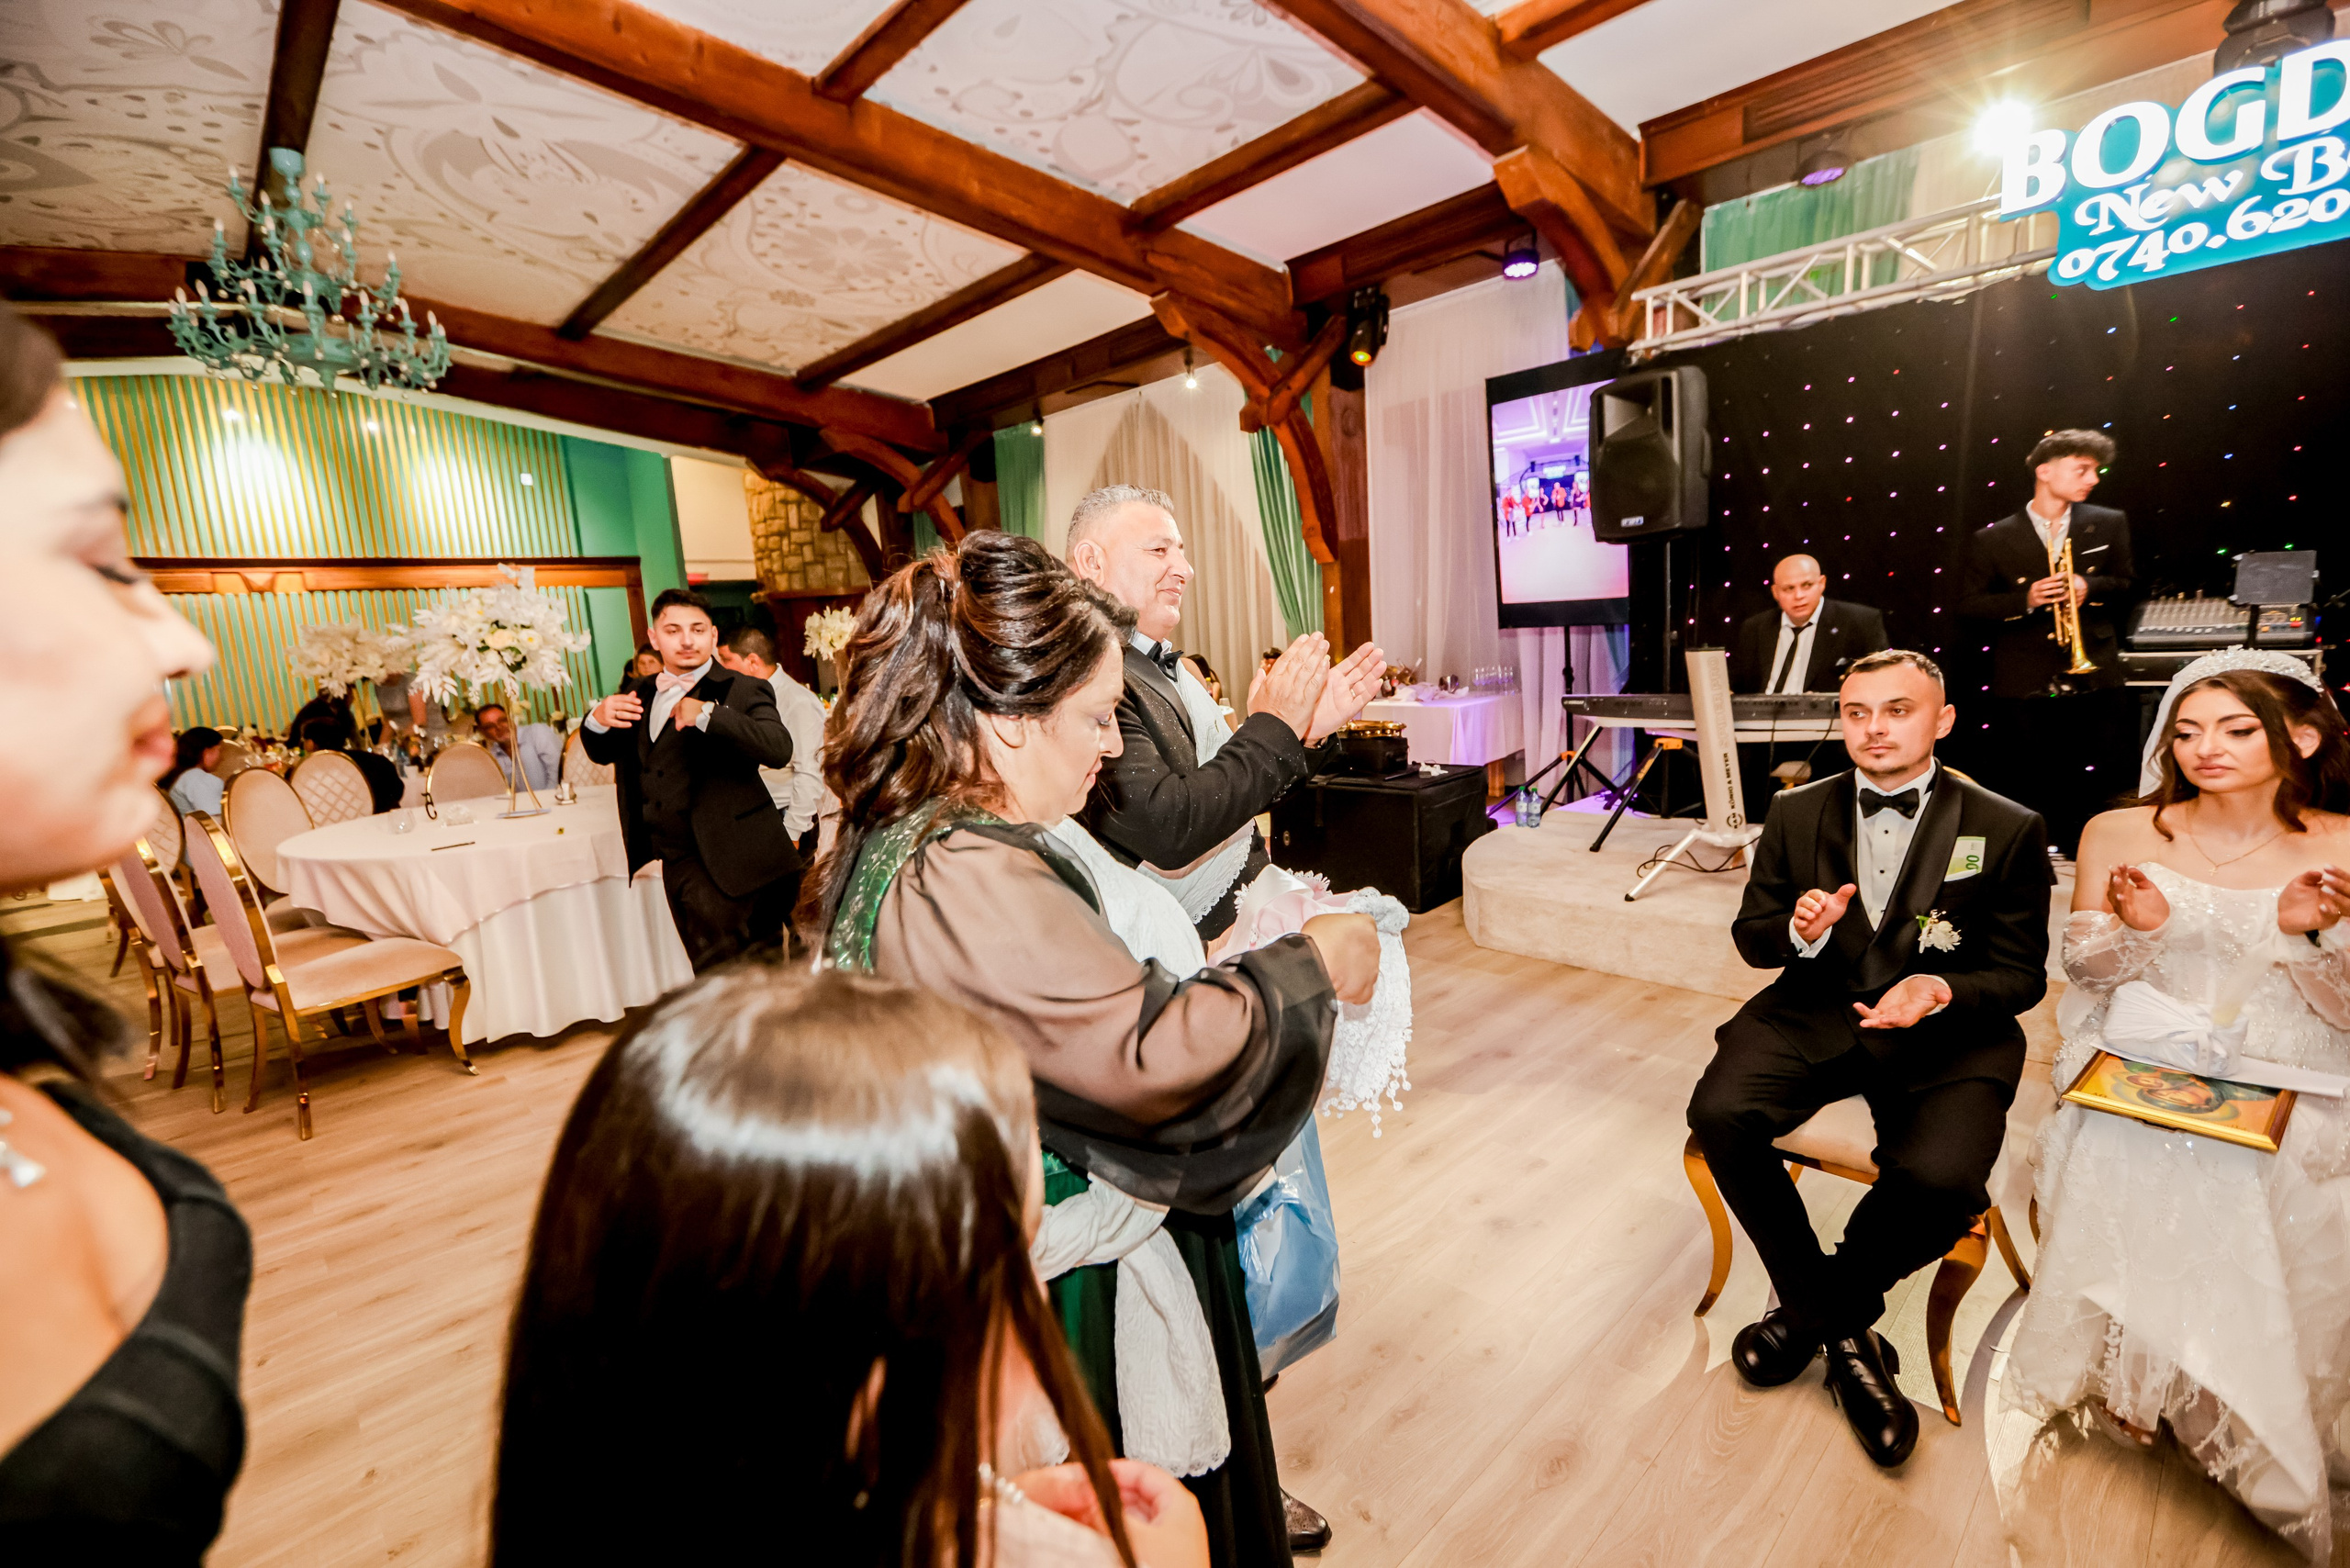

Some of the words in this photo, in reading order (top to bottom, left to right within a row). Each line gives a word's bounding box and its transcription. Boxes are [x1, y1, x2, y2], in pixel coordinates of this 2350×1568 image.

[2000, 39, 2350, 216] BOGD
[2056, 187, 2350, 282] 0740.620
[2074, 169, 2244, 237] New
[2260, 136, 2350, 196] B
[1965, 855, 1980, 870] 00
